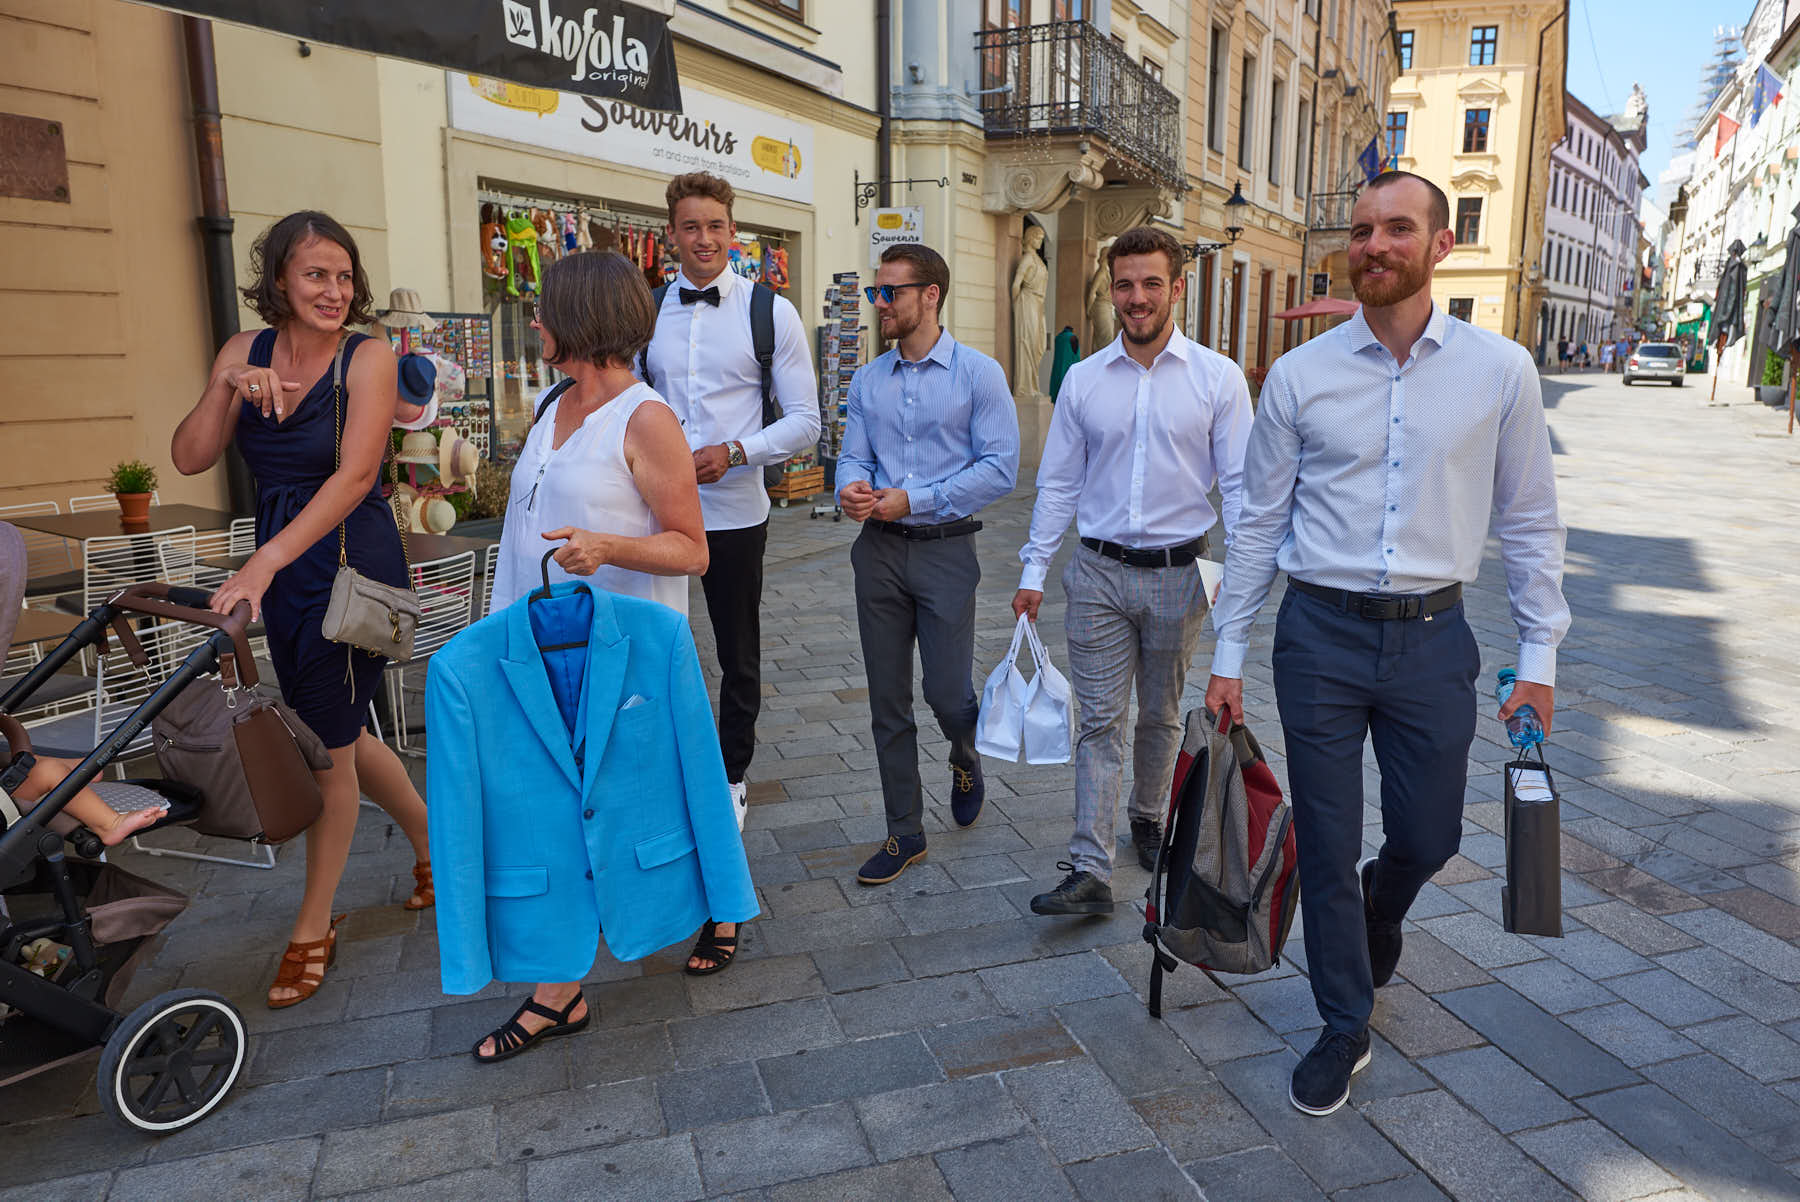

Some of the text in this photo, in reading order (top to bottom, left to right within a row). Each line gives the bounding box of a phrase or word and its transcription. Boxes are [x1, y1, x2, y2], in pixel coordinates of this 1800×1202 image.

[540, 0, 649, 82] kofola
[581, 96, 738, 154] Souvenirs
[872, 232, 919, 245] Souvenirs
